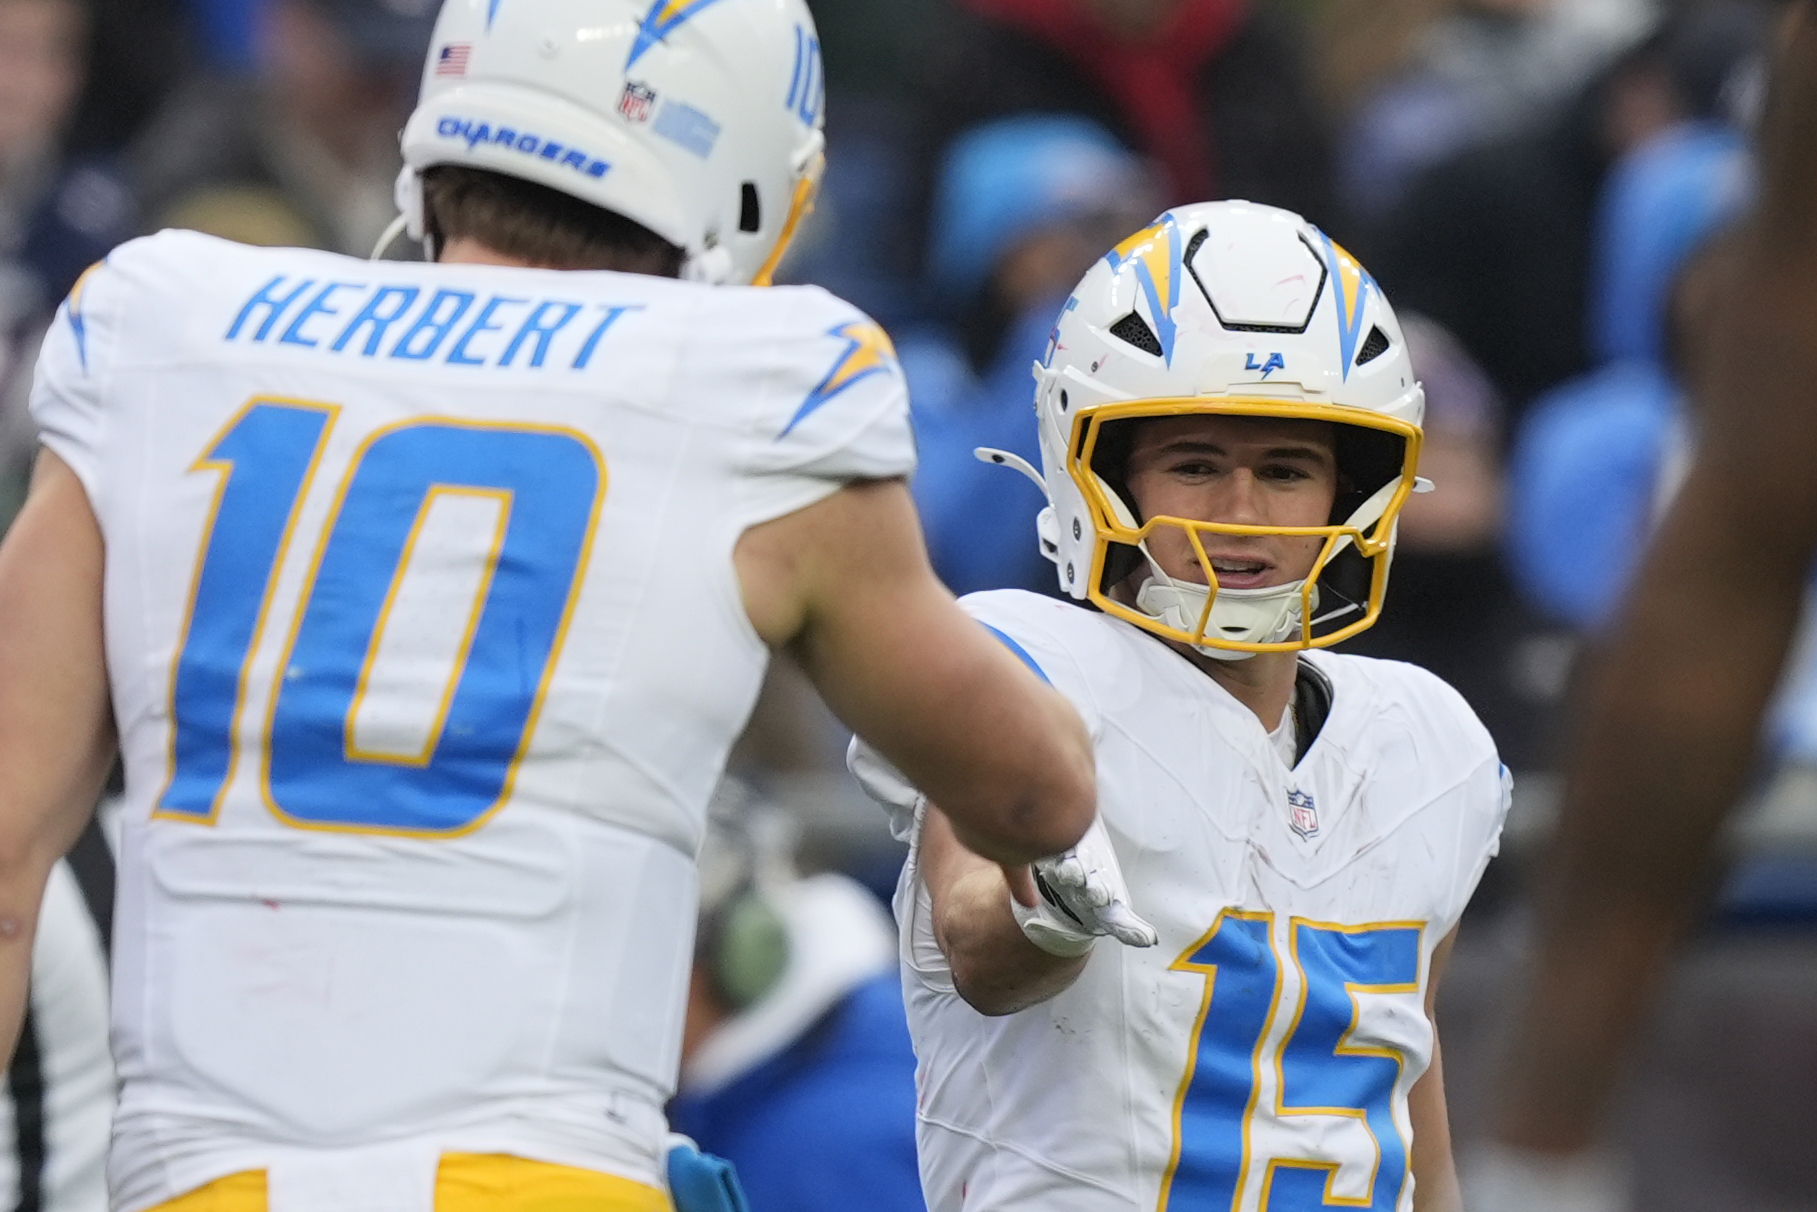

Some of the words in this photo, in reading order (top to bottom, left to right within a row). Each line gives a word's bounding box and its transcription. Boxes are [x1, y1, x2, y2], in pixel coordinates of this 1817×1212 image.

[786, 24, 825, 126] 10
[438, 116, 611, 178] CHARGERS
[225, 274, 645, 371] HERBERT
[1245, 352, 1285, 380] LA
[150, 394, 608, 841] 10
[1293, 807, 1316, 829] NFL
[1156, 906, 1428, 1212] 15
